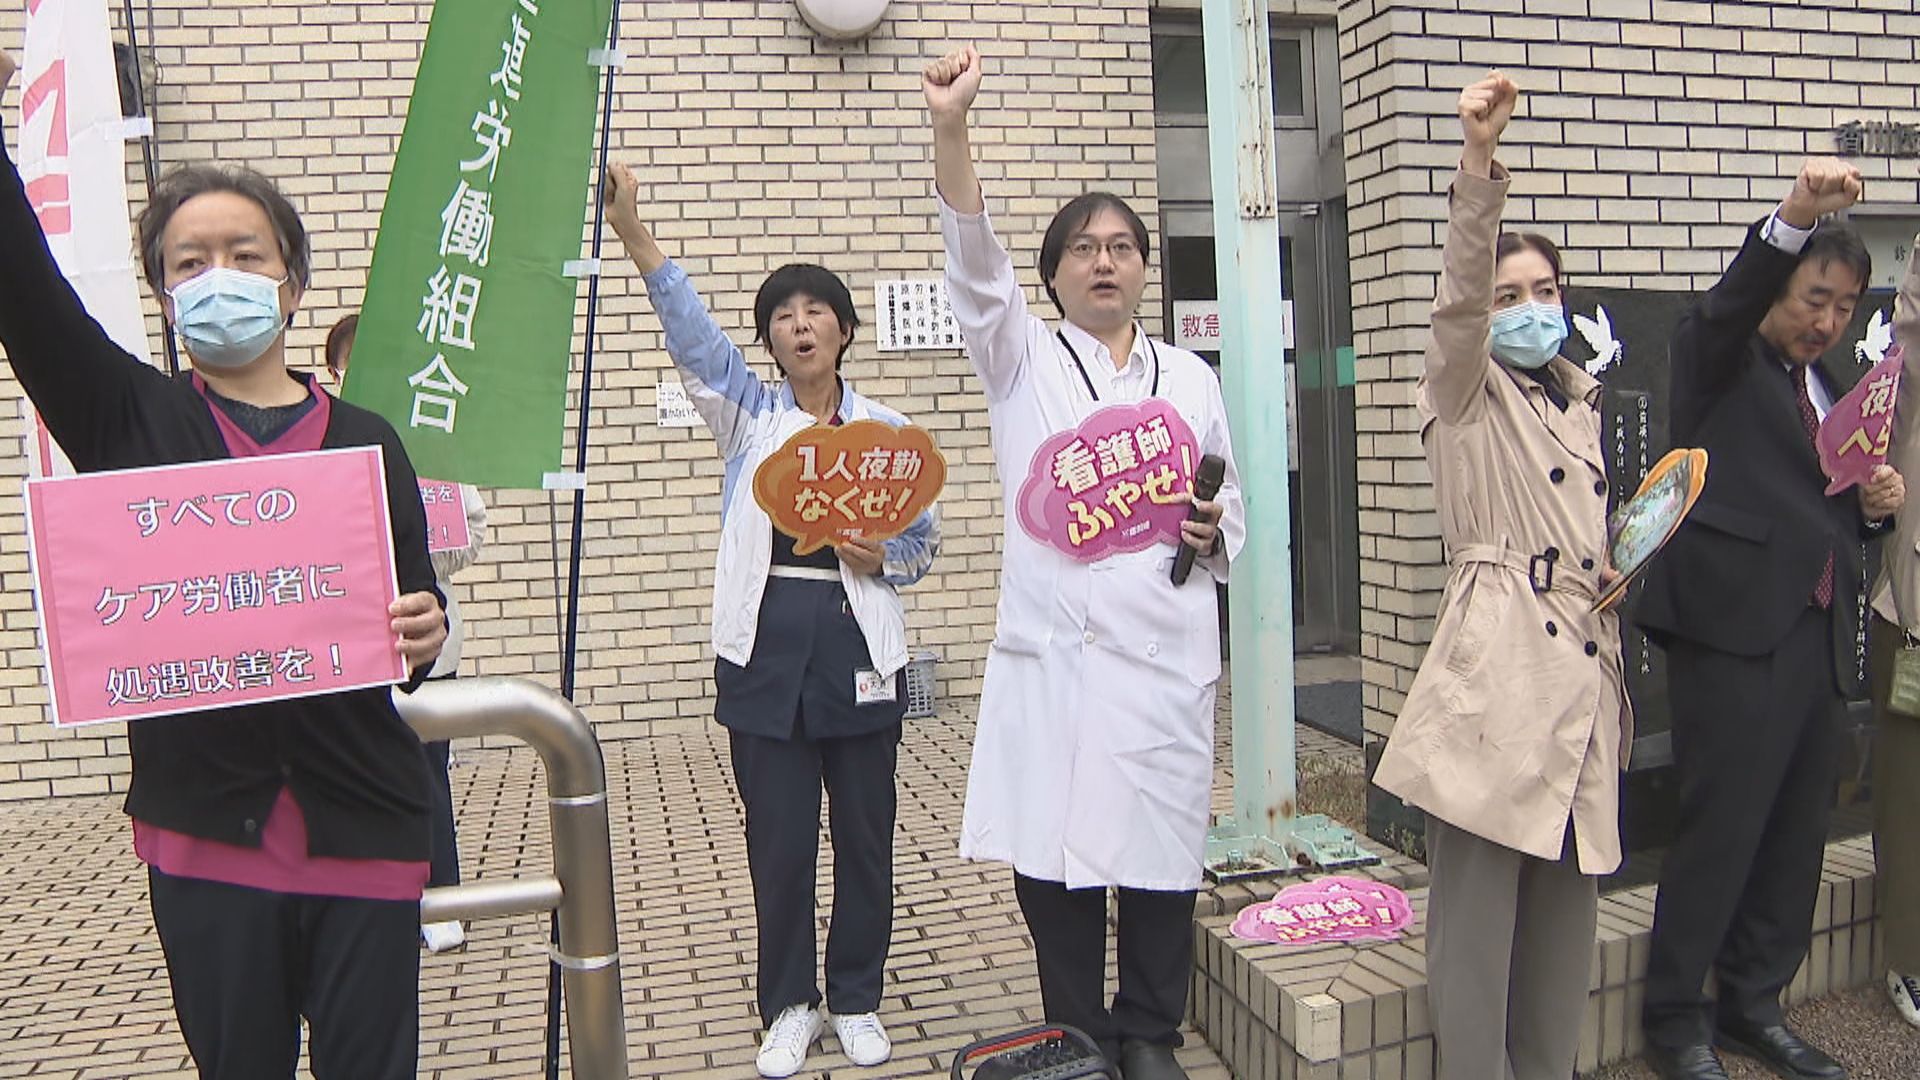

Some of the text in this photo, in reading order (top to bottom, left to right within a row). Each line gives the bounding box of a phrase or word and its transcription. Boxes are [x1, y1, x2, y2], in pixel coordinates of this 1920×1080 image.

[408, 0, 538, 434] 連労働組合
[797, 446, 923, 482] 1人夜勤
[1052, 415, 1174, 496] 看護師
[127, 488, 297, 538] すべての
[794, 486, 913, 523] なくせ!
[95, 563, 346, 626] ケア労働者に
[105, 643, 343, 707] 処遇改善を！
